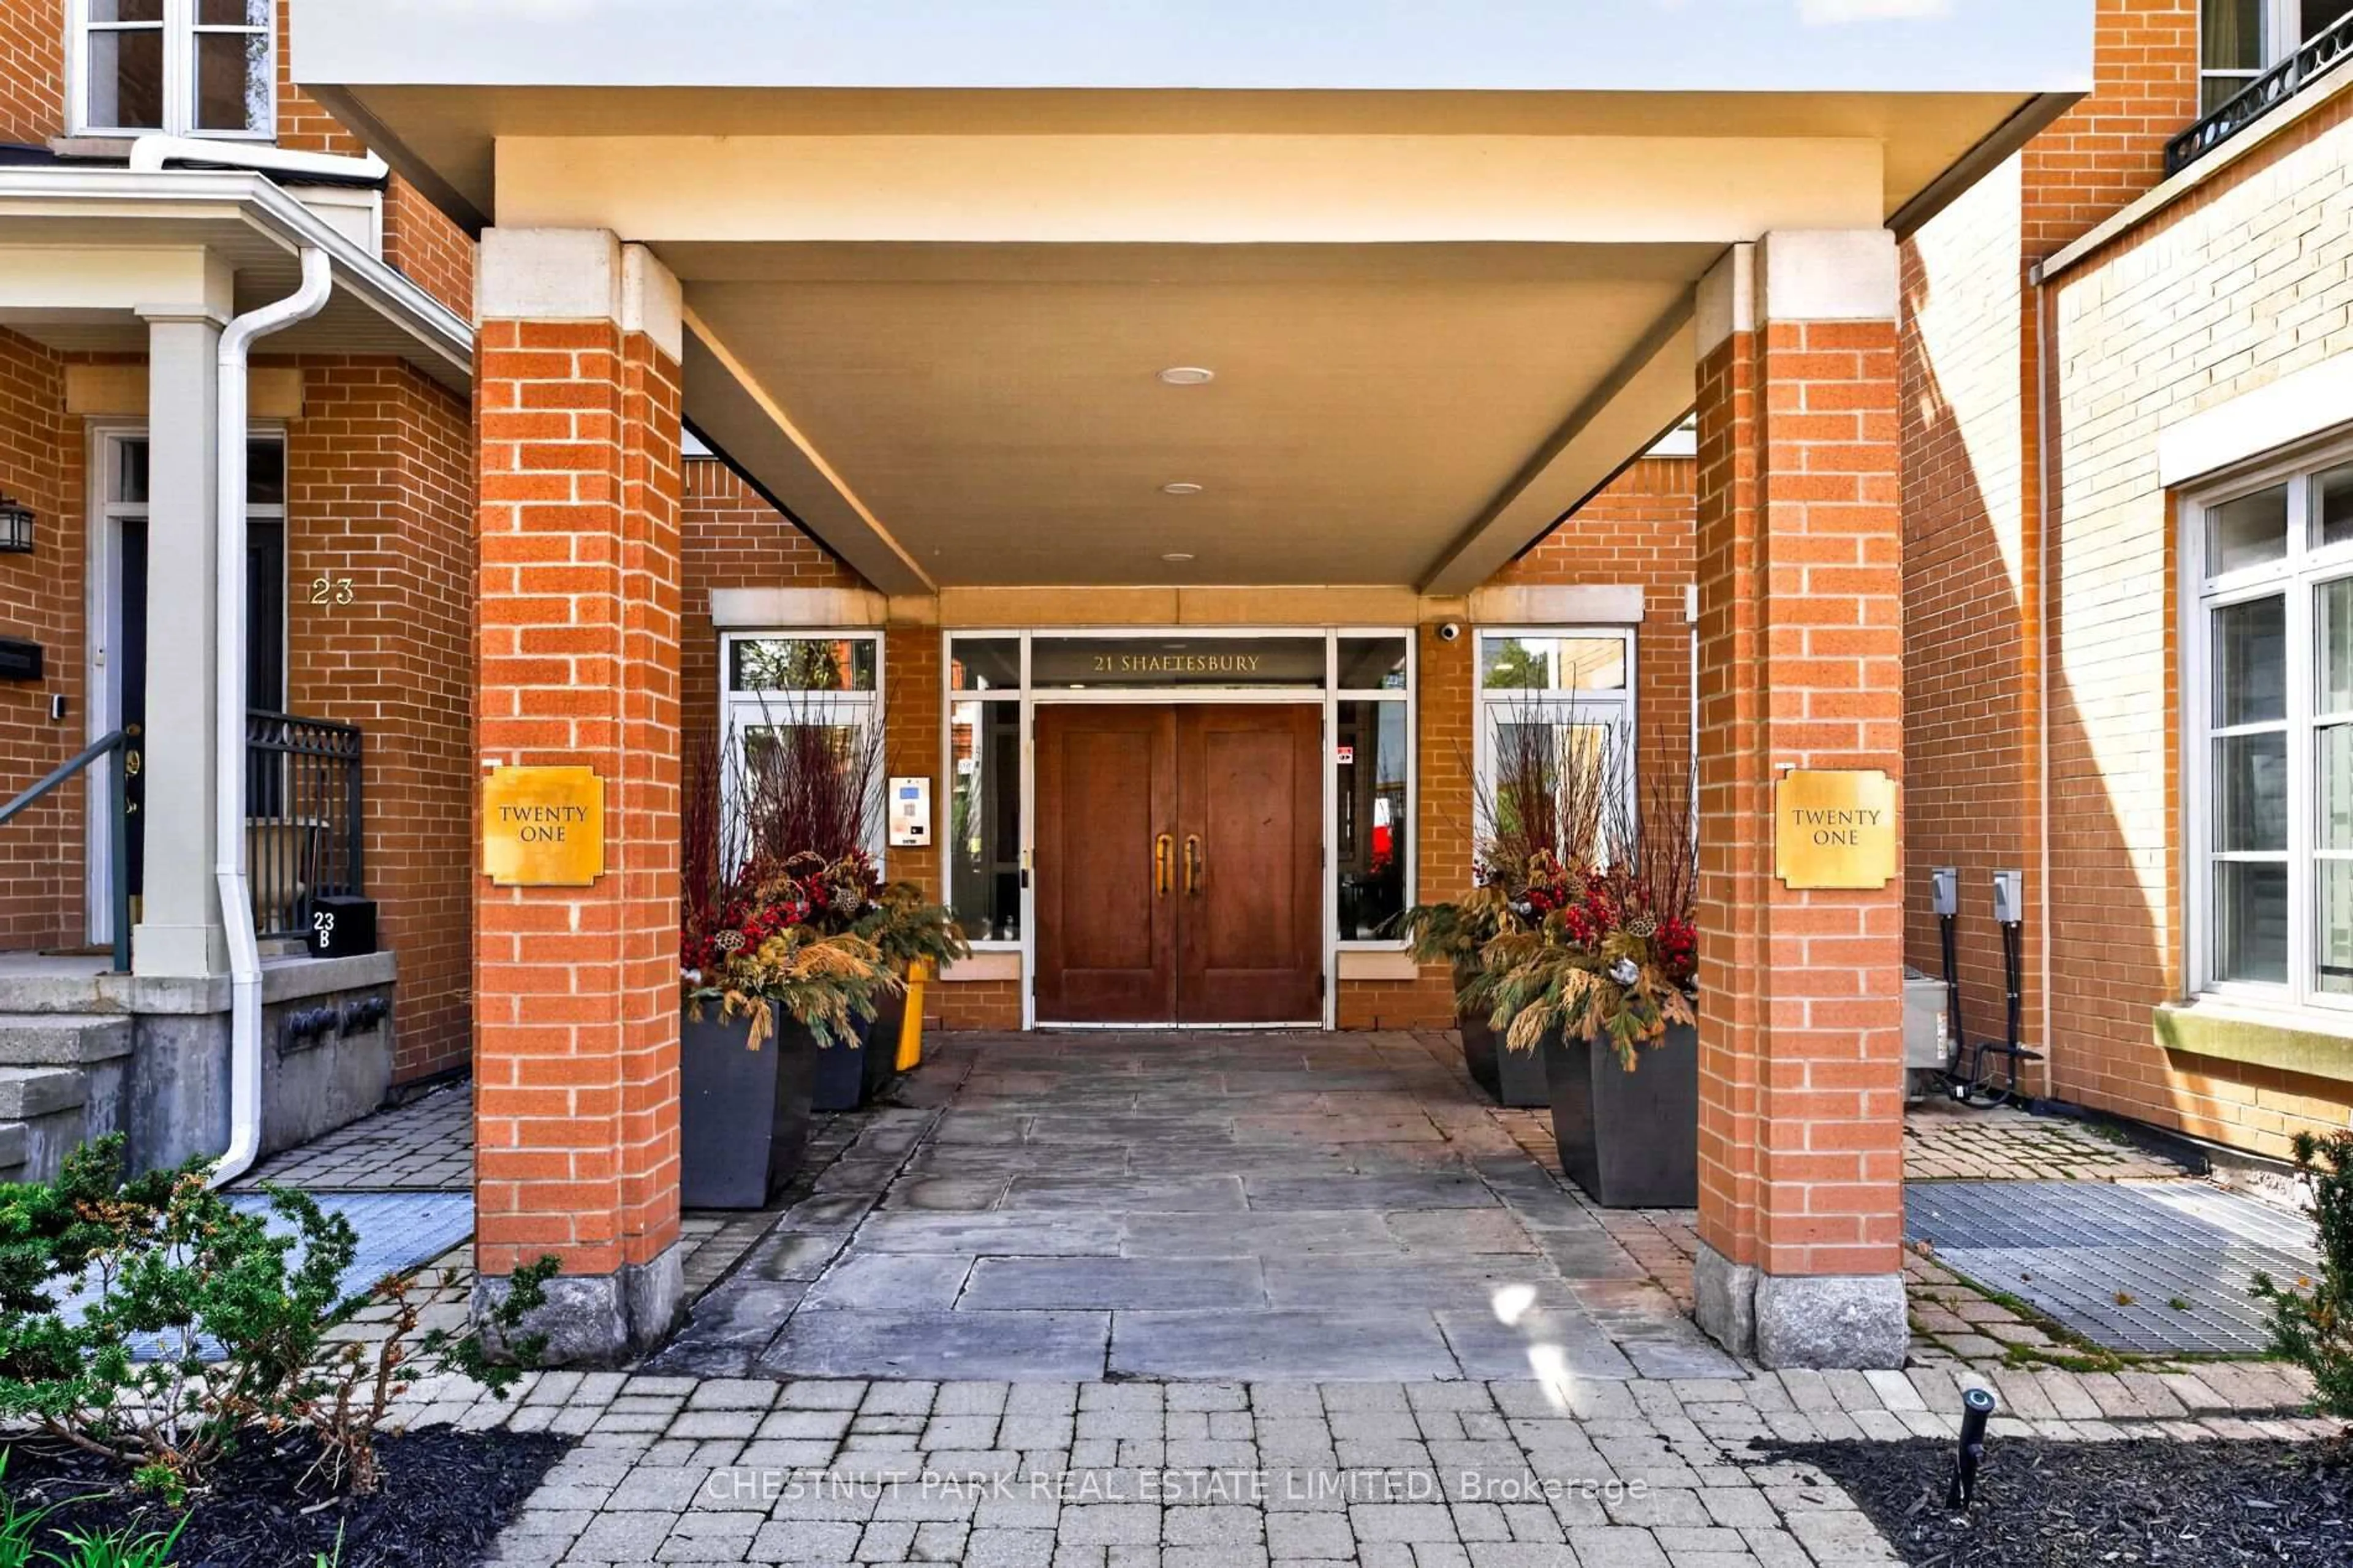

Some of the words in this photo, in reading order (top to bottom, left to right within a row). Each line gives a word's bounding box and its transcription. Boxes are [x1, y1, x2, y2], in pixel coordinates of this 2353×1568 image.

[311, 578, 354, 605] 23
[1093, 656, 1112, 672] 21
[1121, 655, 1260, 672] SHAFTESBURY
[499, 806, 588, 822] TWENTY
[1792, 809, 1881, 825] TWENTY
[520, 825, 566, 843] ONE
[1813, 829, 1859, 846] ONE
[313, 911, 335, 931] 23
[319, 930, 330, 949] B
